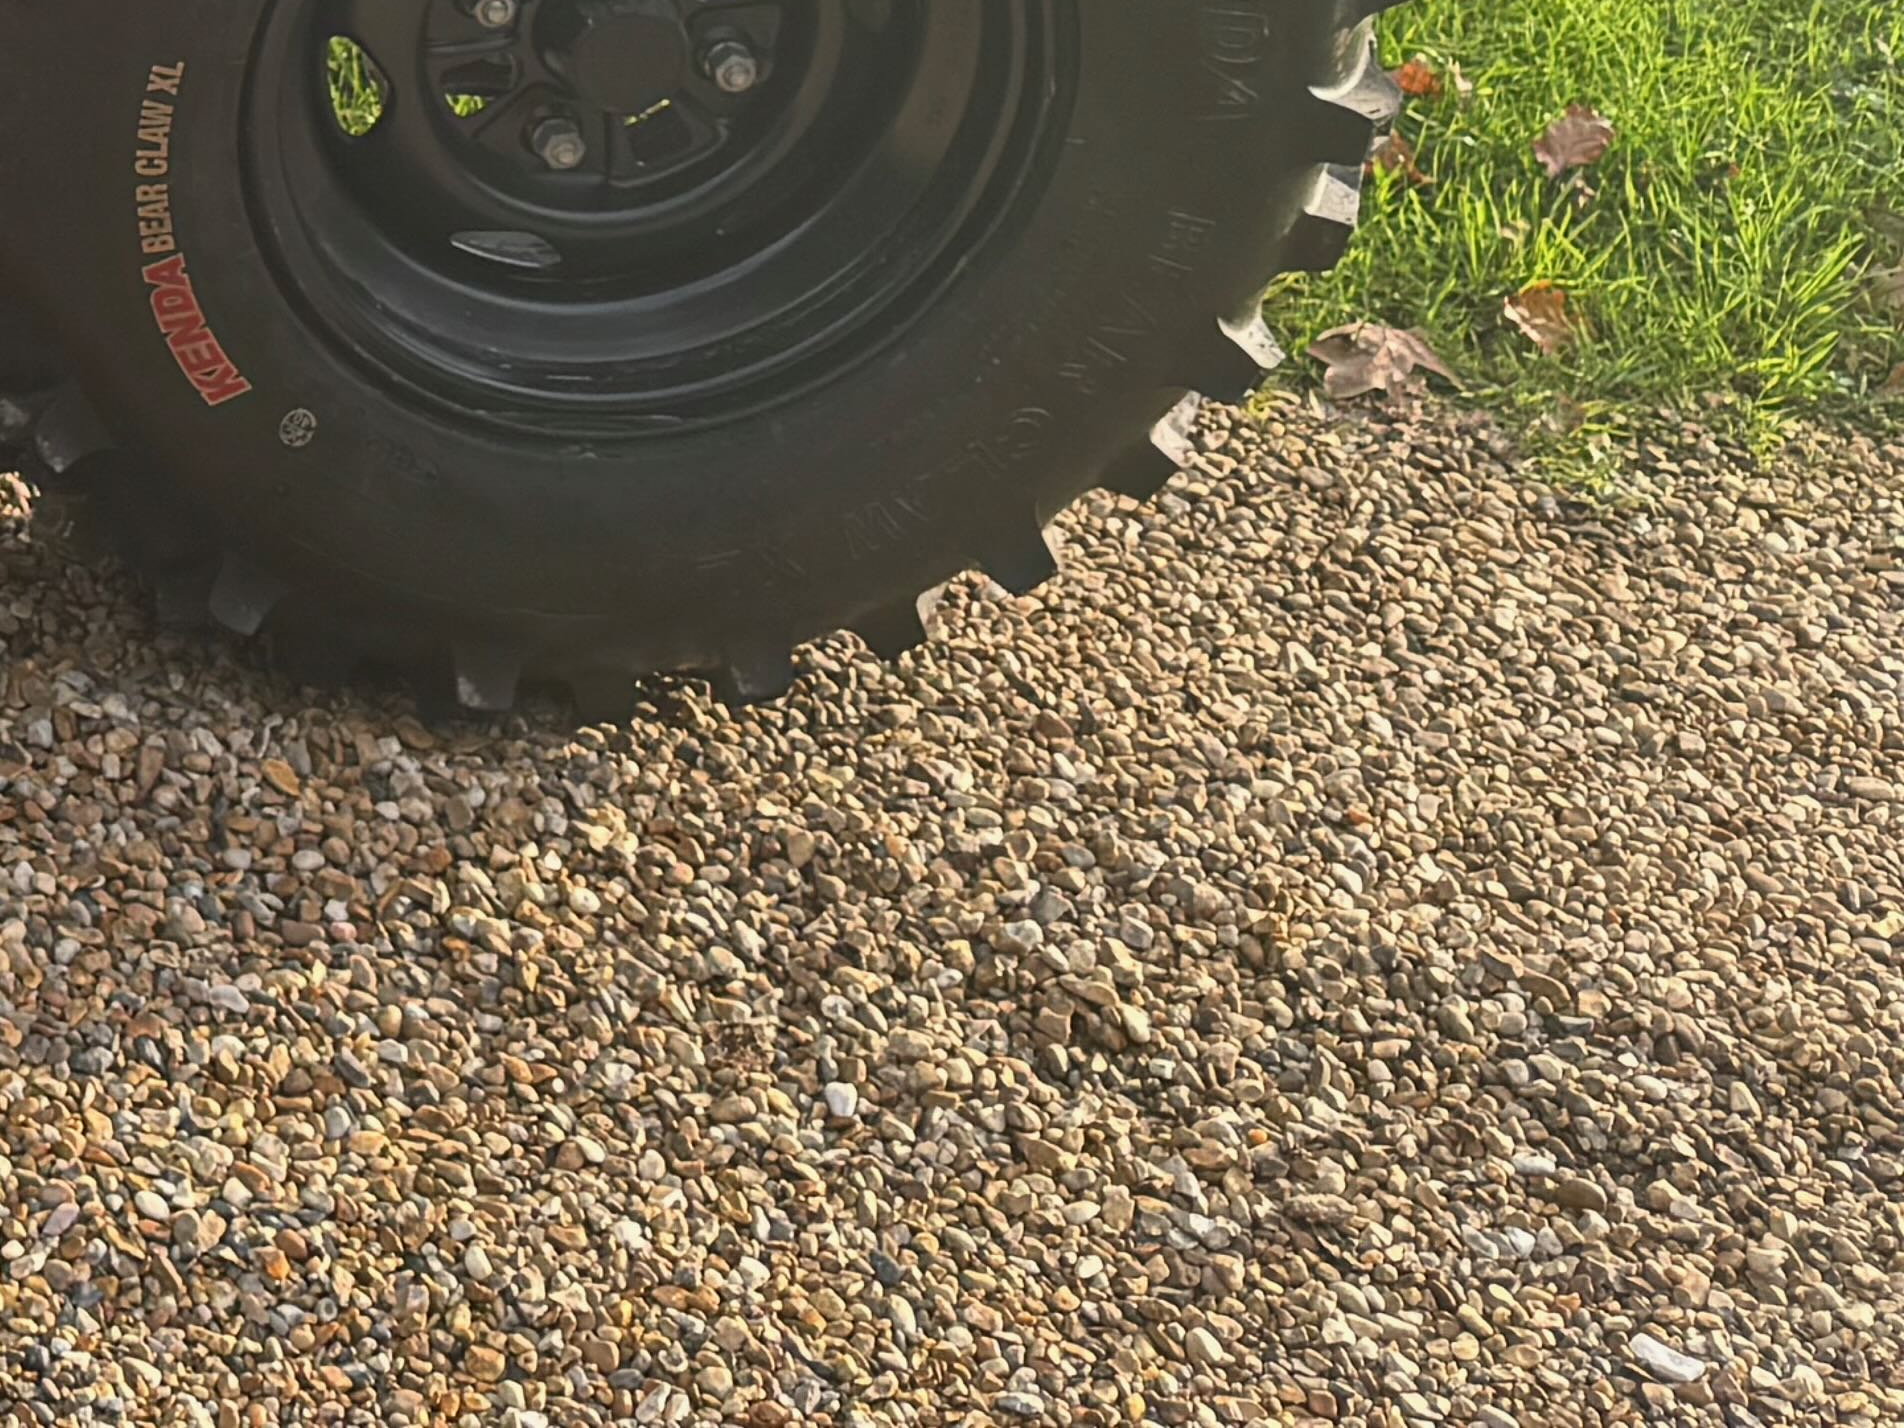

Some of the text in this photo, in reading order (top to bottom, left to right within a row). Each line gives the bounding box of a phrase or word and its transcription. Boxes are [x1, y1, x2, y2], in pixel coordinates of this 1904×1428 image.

[135, 60, 253, 406] KENDA BEAR CLAW XL
